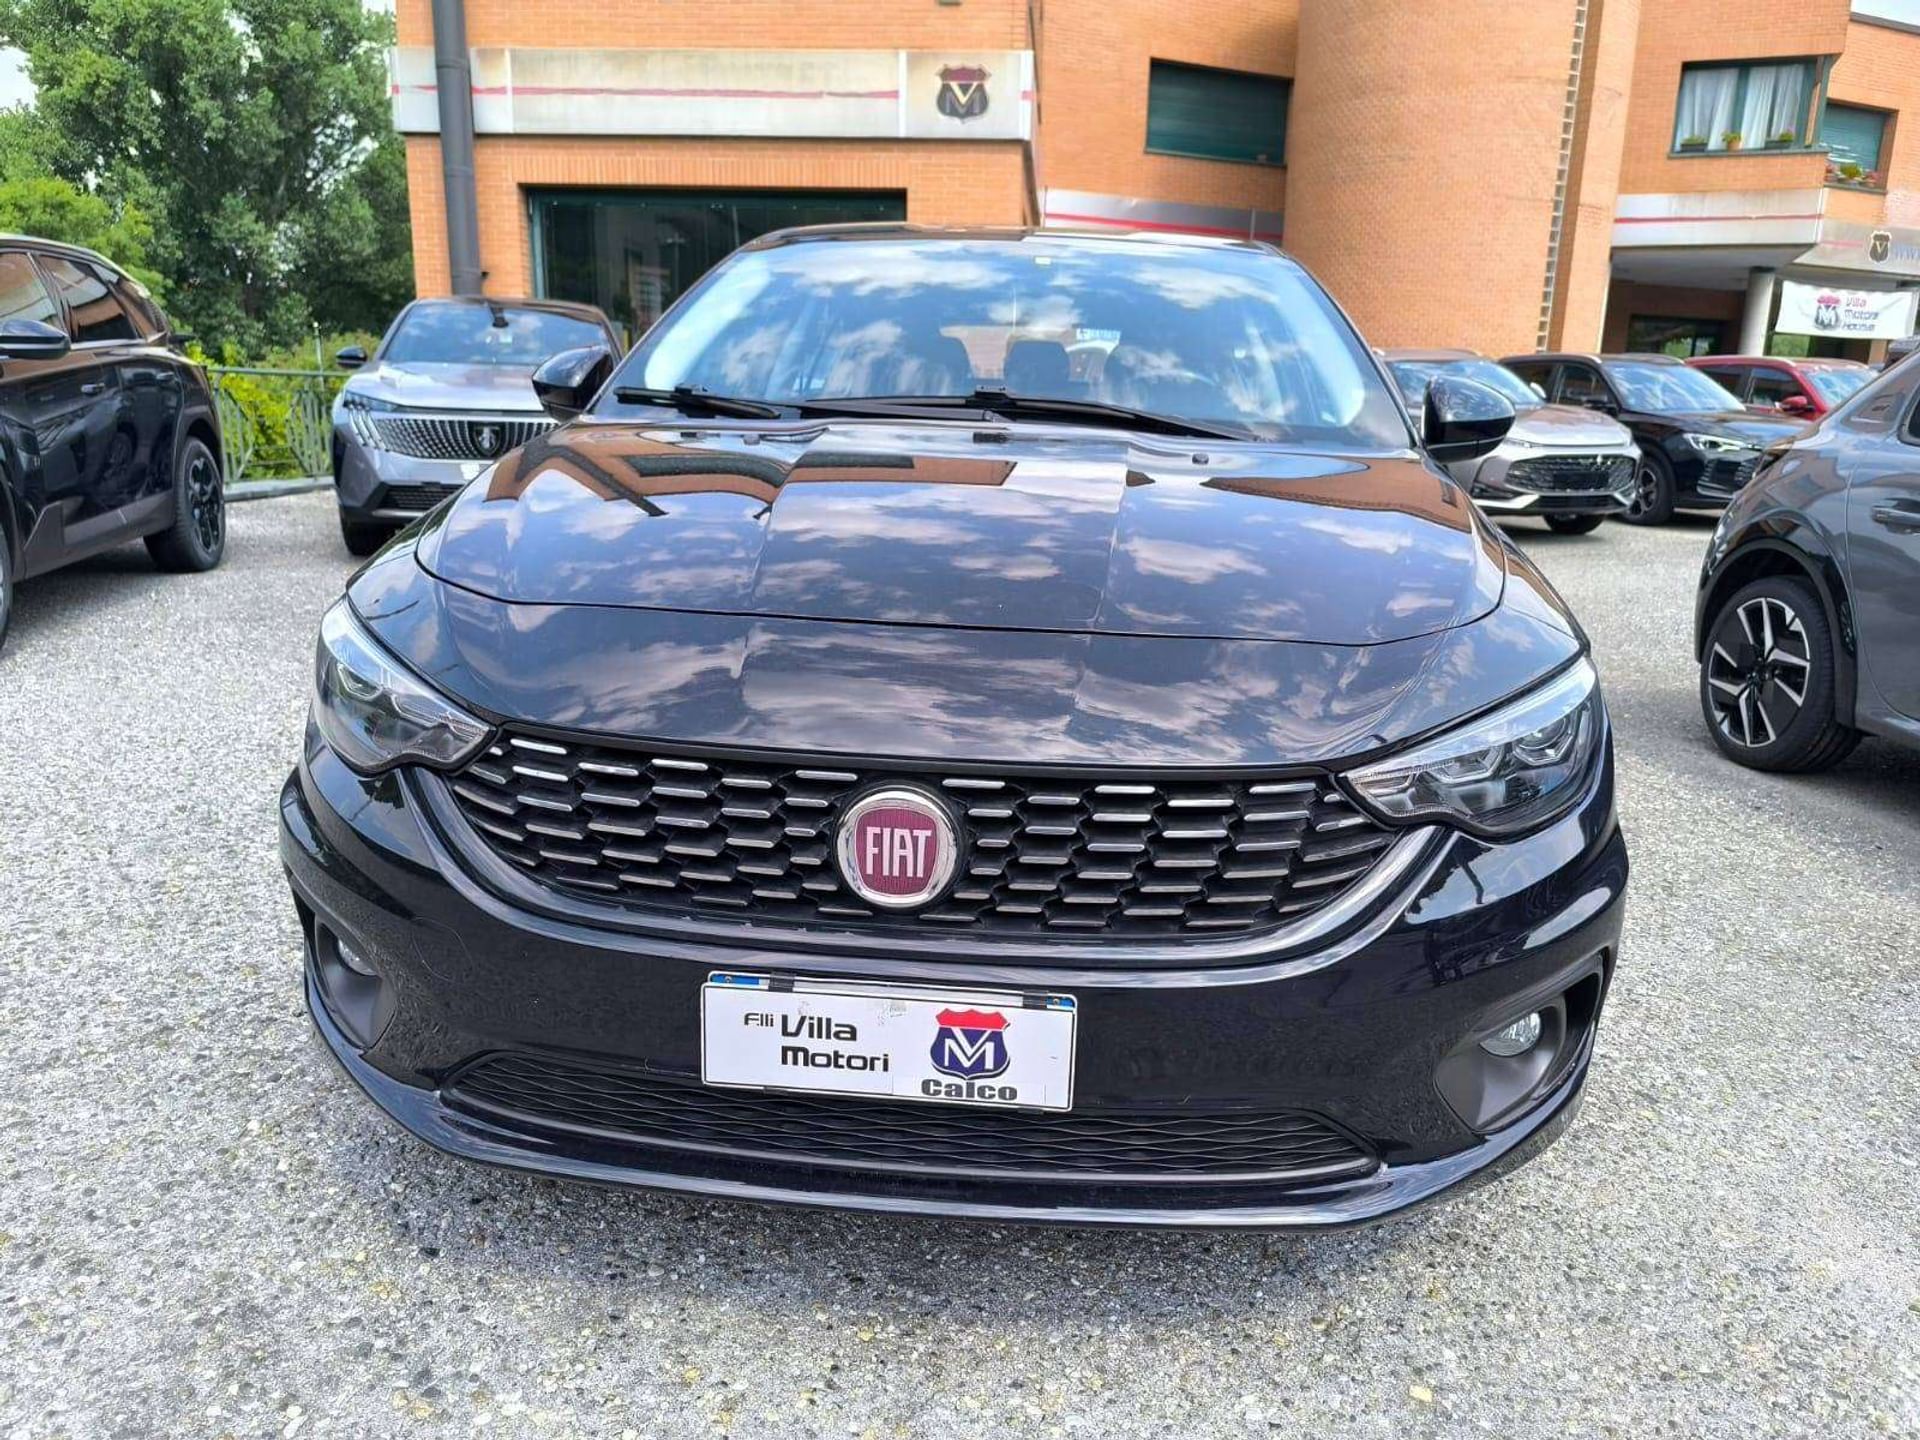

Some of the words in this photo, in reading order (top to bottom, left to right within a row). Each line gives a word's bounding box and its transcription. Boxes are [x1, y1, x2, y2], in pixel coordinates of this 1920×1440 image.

[866, 826, 932, 878] FIAT
[781, 1013, 857, 1042] Villa
[781, 1045, 889, 1072] Motori
[921, 1078, 1018, 1101] Calco
